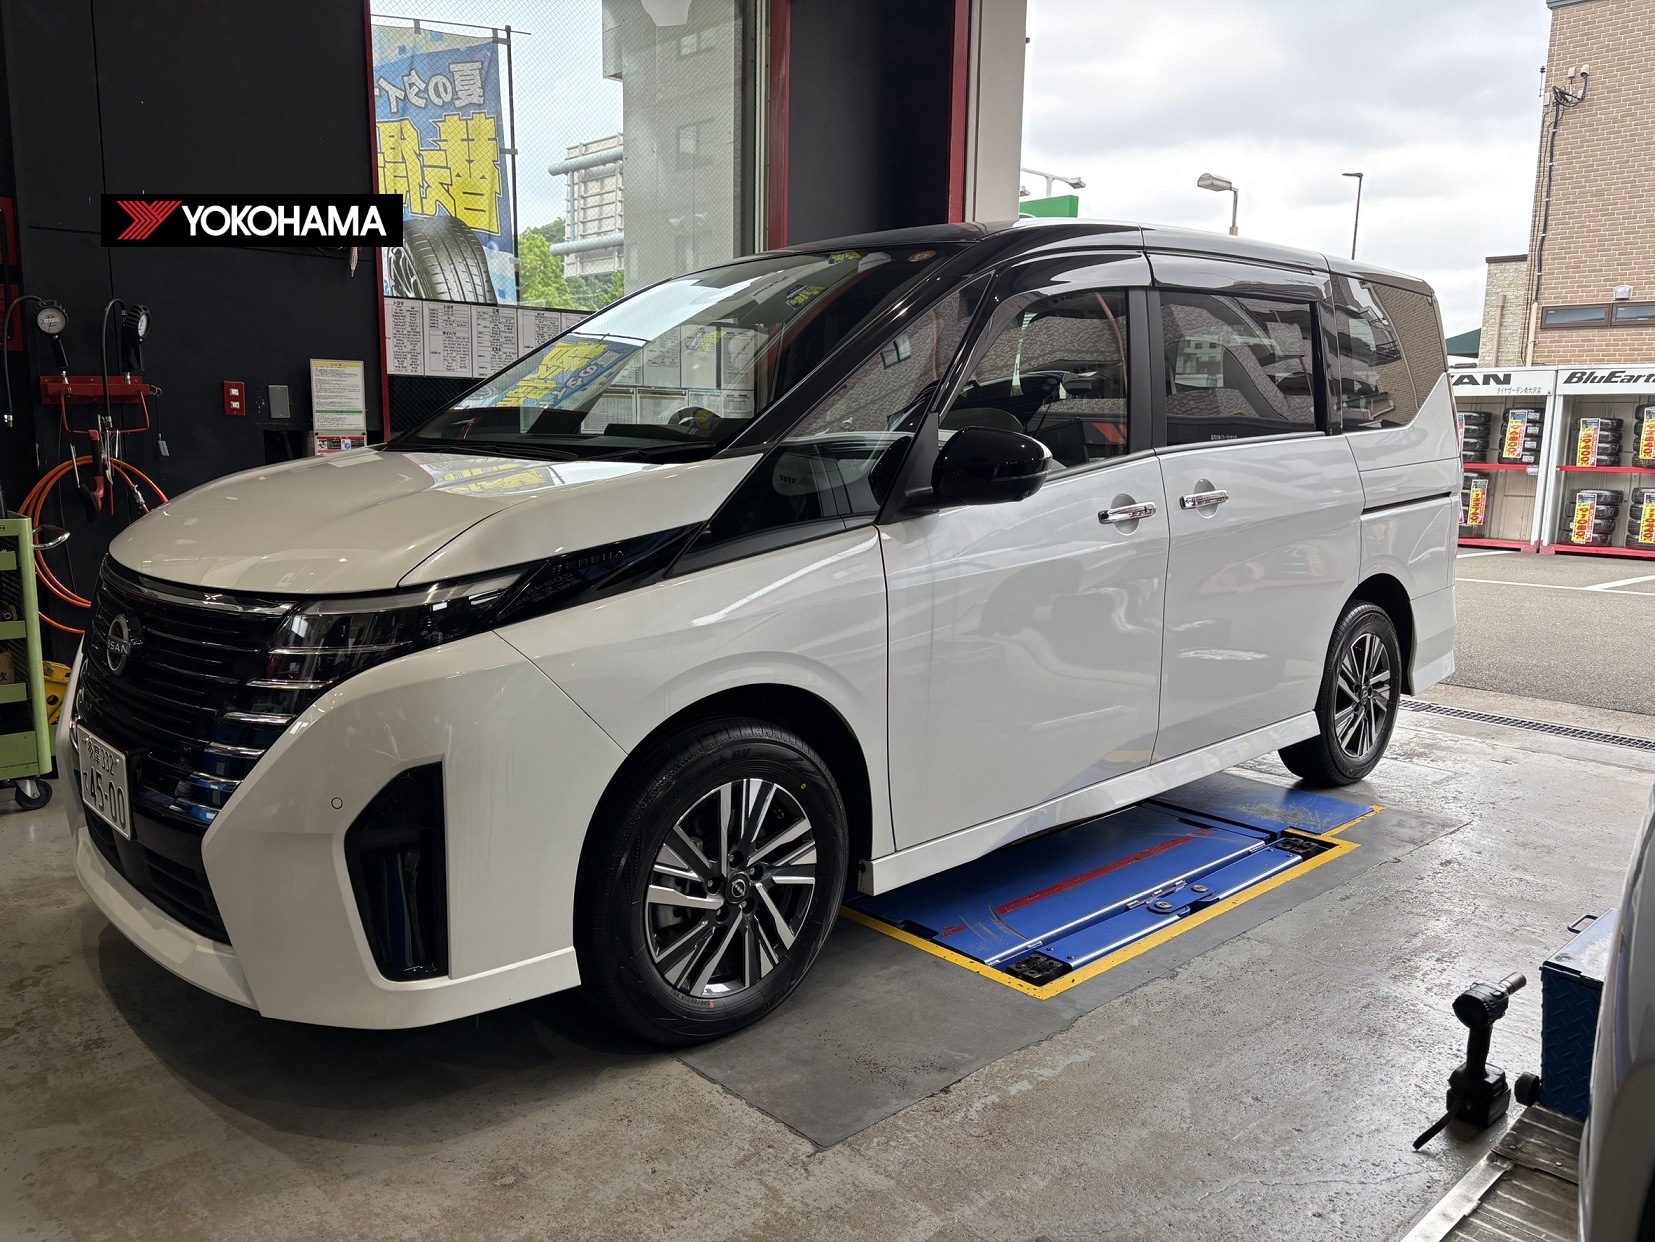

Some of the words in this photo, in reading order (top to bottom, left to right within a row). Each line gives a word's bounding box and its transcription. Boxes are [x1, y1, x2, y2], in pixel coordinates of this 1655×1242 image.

[1450, 373, 1512, 386] AN
[1563, 371, 1655, 384] BluEart
[107, 639, 128, 654] SSAN
[91, 766, 126, 830] 45-00
